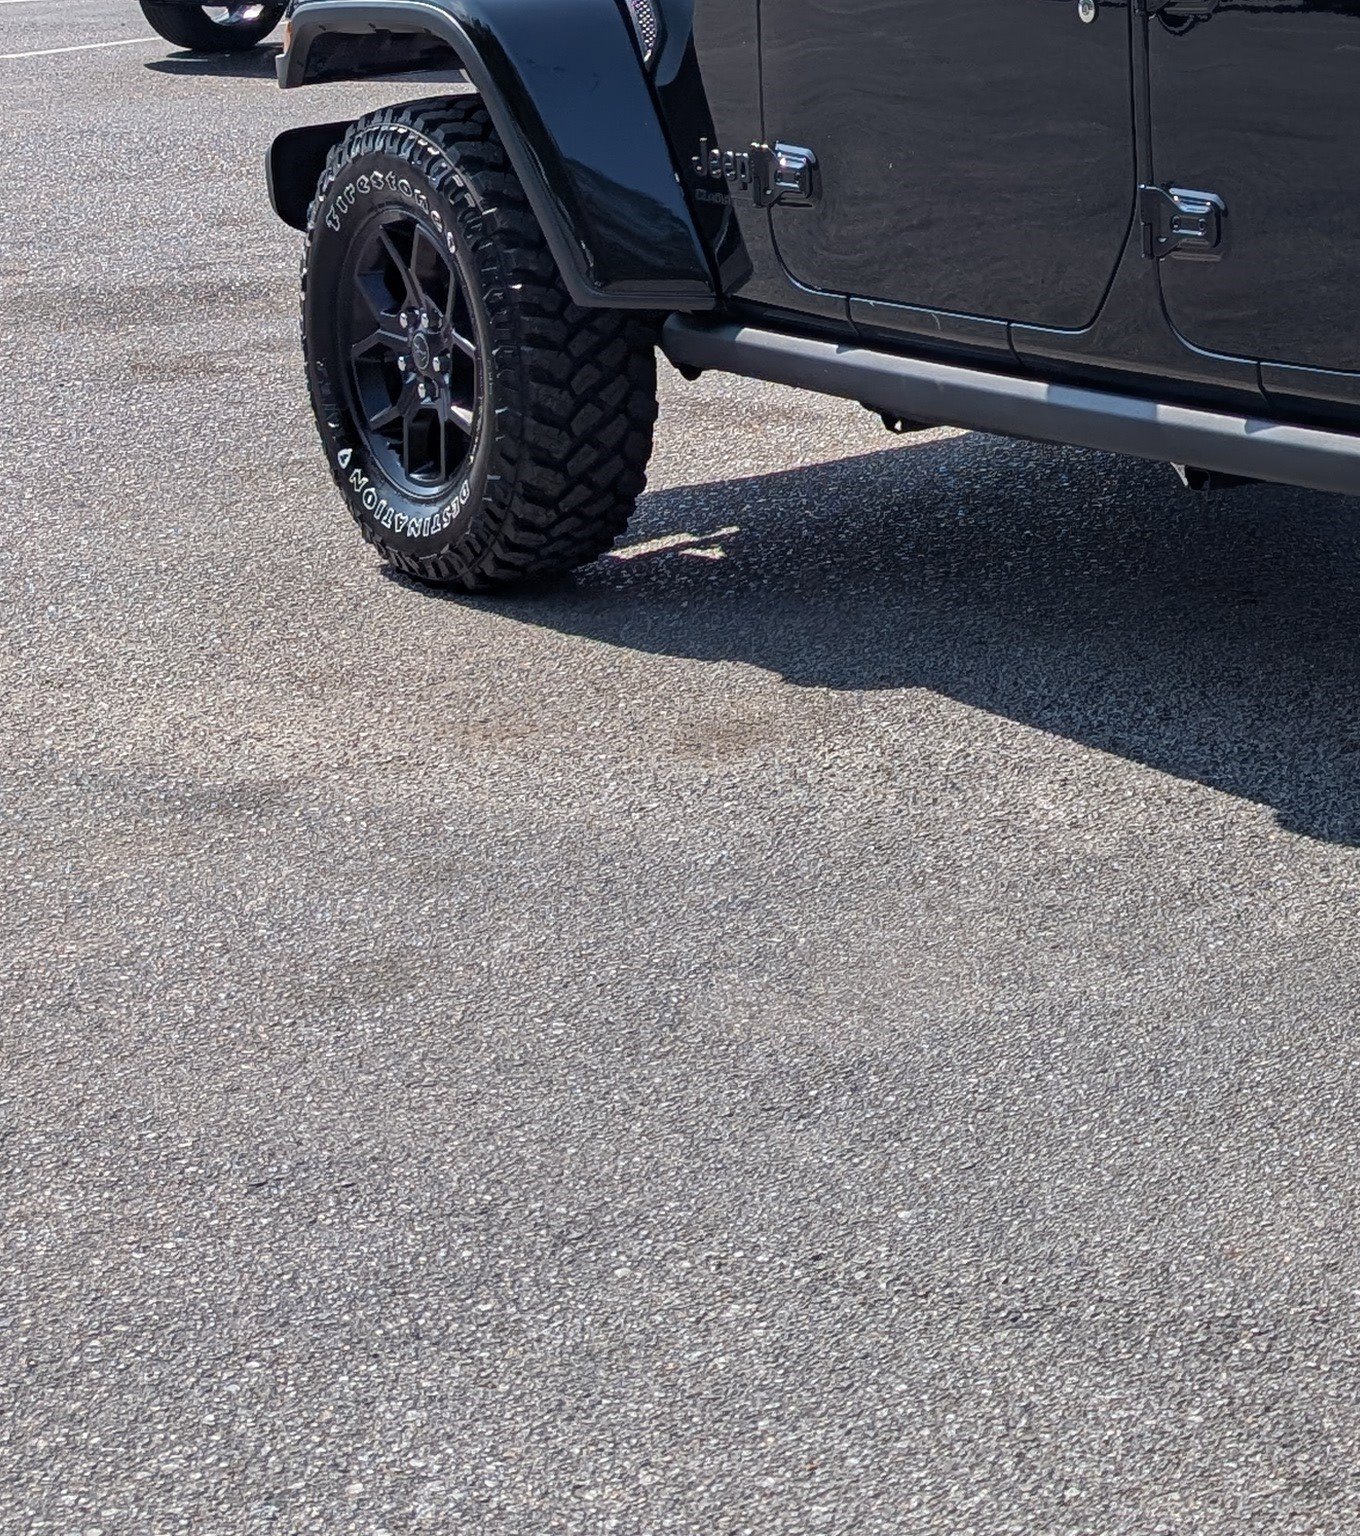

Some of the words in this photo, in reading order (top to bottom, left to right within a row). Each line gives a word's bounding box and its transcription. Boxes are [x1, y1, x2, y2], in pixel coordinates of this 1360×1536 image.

[691, 137, 749, 191] Jeep
[325, 170, 444, 233] Firestone
[349, 470, 470, 537] DESTINATION
